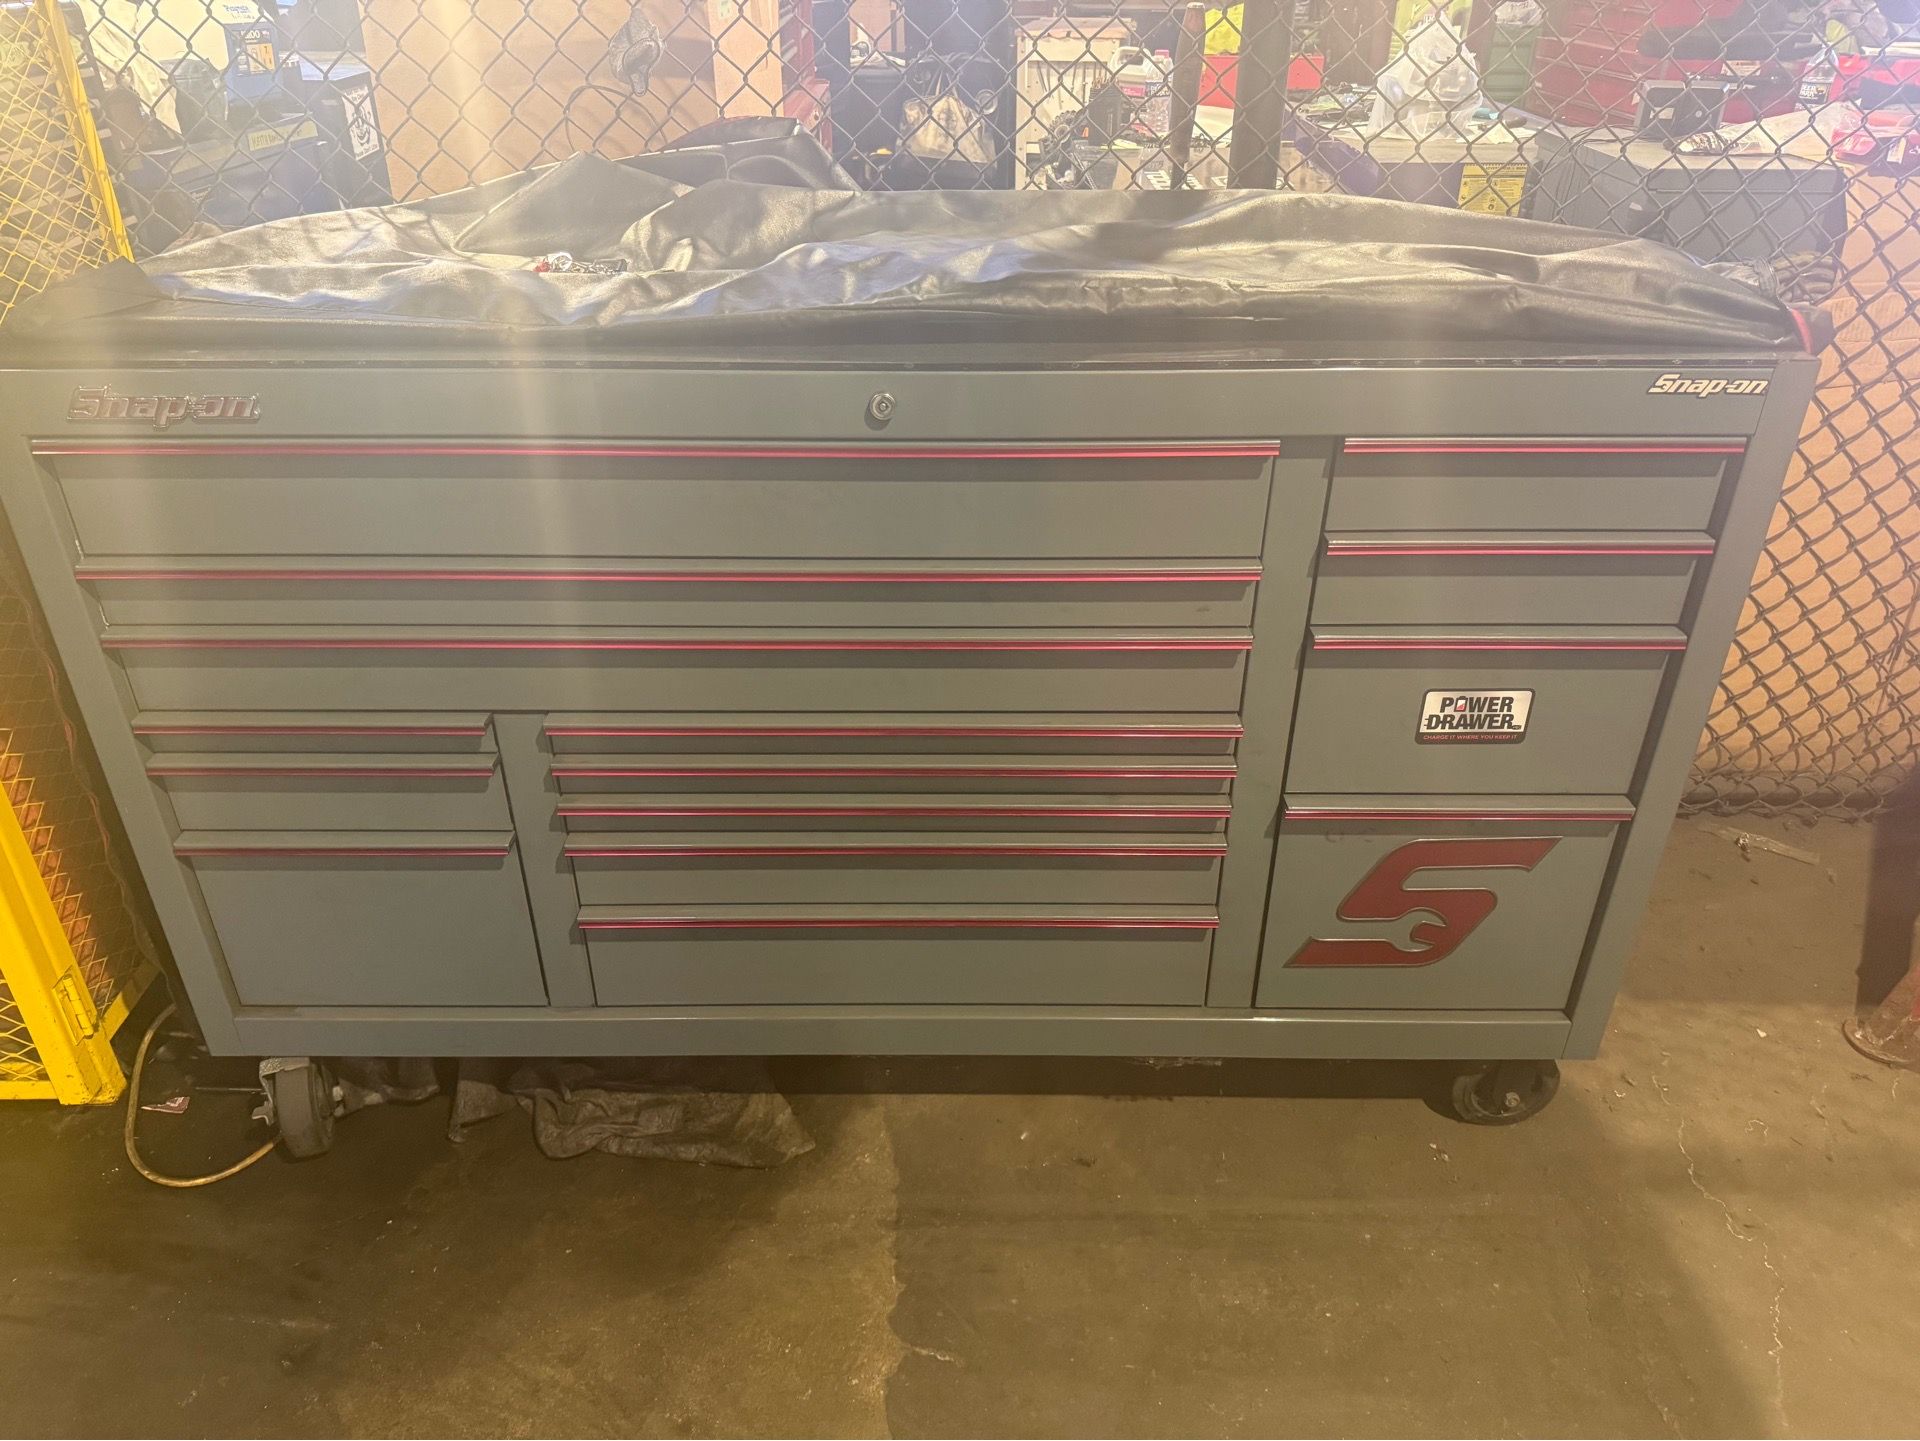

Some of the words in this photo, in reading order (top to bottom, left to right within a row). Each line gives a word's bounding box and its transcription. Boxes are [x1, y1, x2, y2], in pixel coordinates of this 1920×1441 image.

[1647, 373, 1769, 398] Snap-on
[67, 385, 259, 428] Snap-on
[1440, 696, 1514, 713] POWER
[1425, 713, 1515, 730] DRAWER
